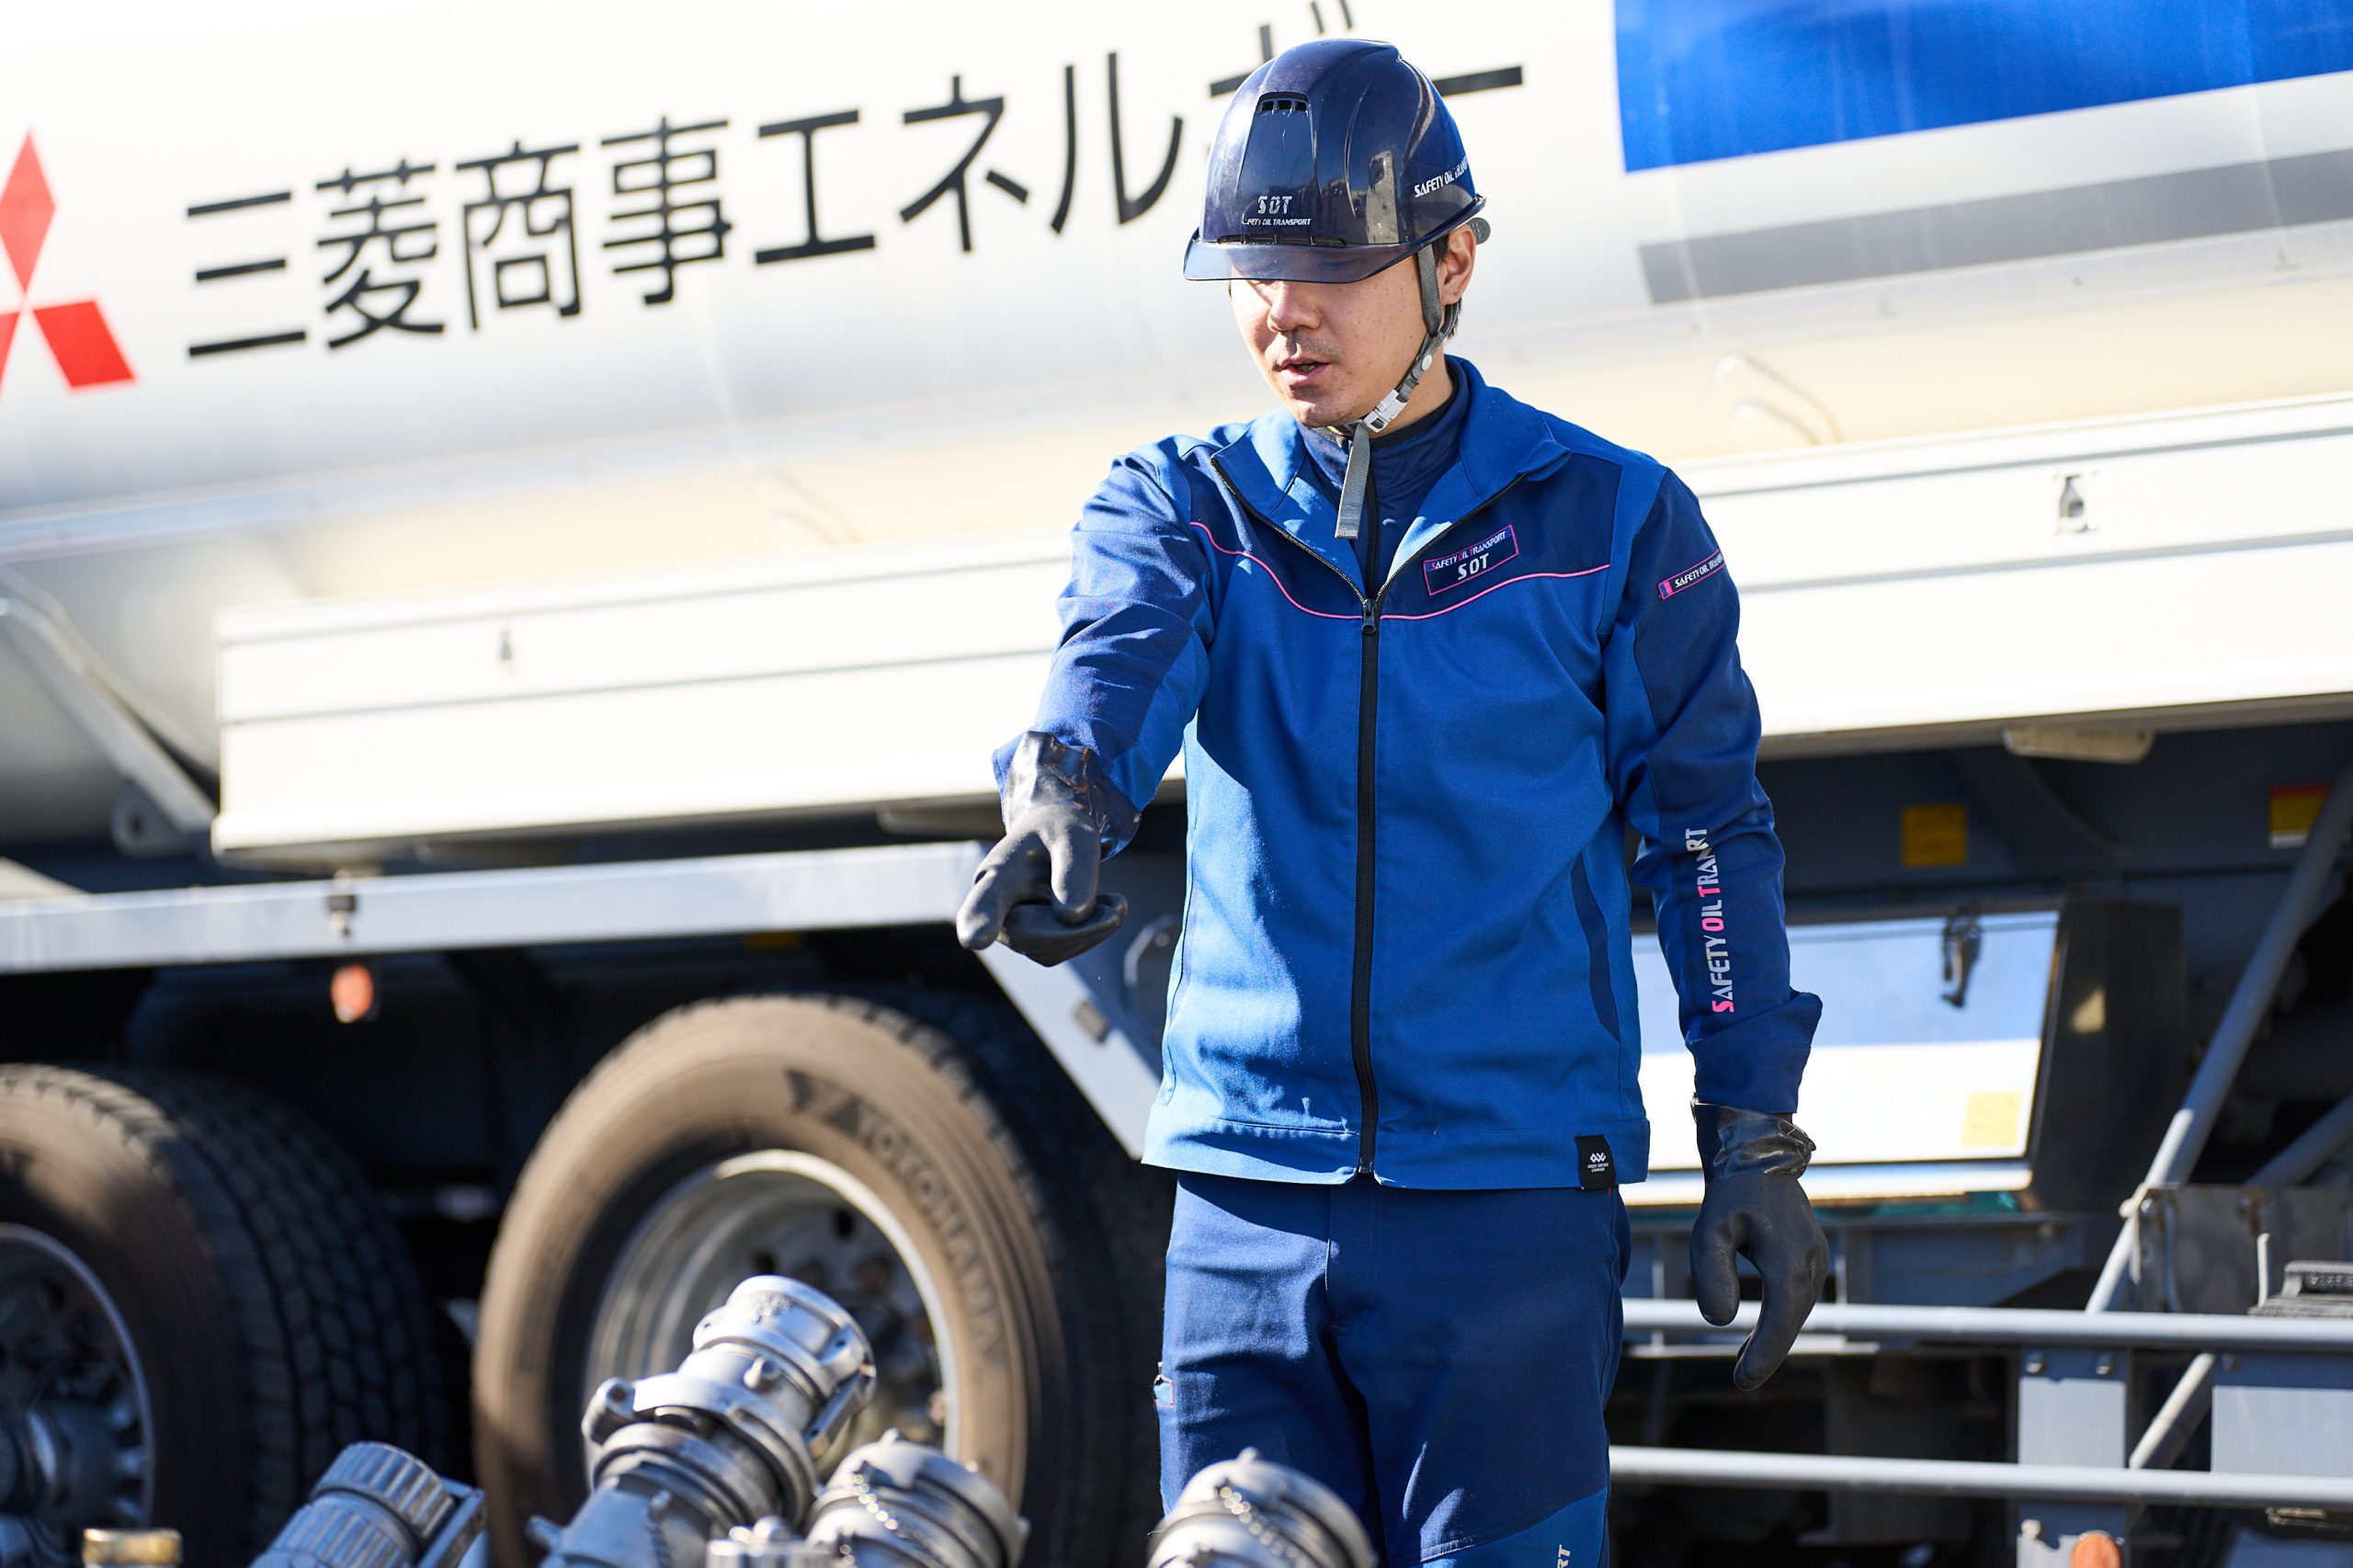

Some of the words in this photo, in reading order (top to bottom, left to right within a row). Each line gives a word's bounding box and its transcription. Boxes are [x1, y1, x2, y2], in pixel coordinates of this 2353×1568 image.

[1414, 175, 1444, 198] SAFETY
[1257, 196, 1293, 214] SOT
[1272, 218, 1312, 226] TRANSPORT
[1430, 554, 1458, 571] SAFETY
[1458, 550, 1470, 562] OIL
[1470, 531, 1506, 556] TRANSPORT
[1458, 553, 1489, 581] SOT
[1675, 570, 1700, 588] SAFETY
[1699, 563, 1710, 575] OIL
[1701, 900, 1725, 932] OIL
[1703, 935, 1735, 1013] SAFETY
